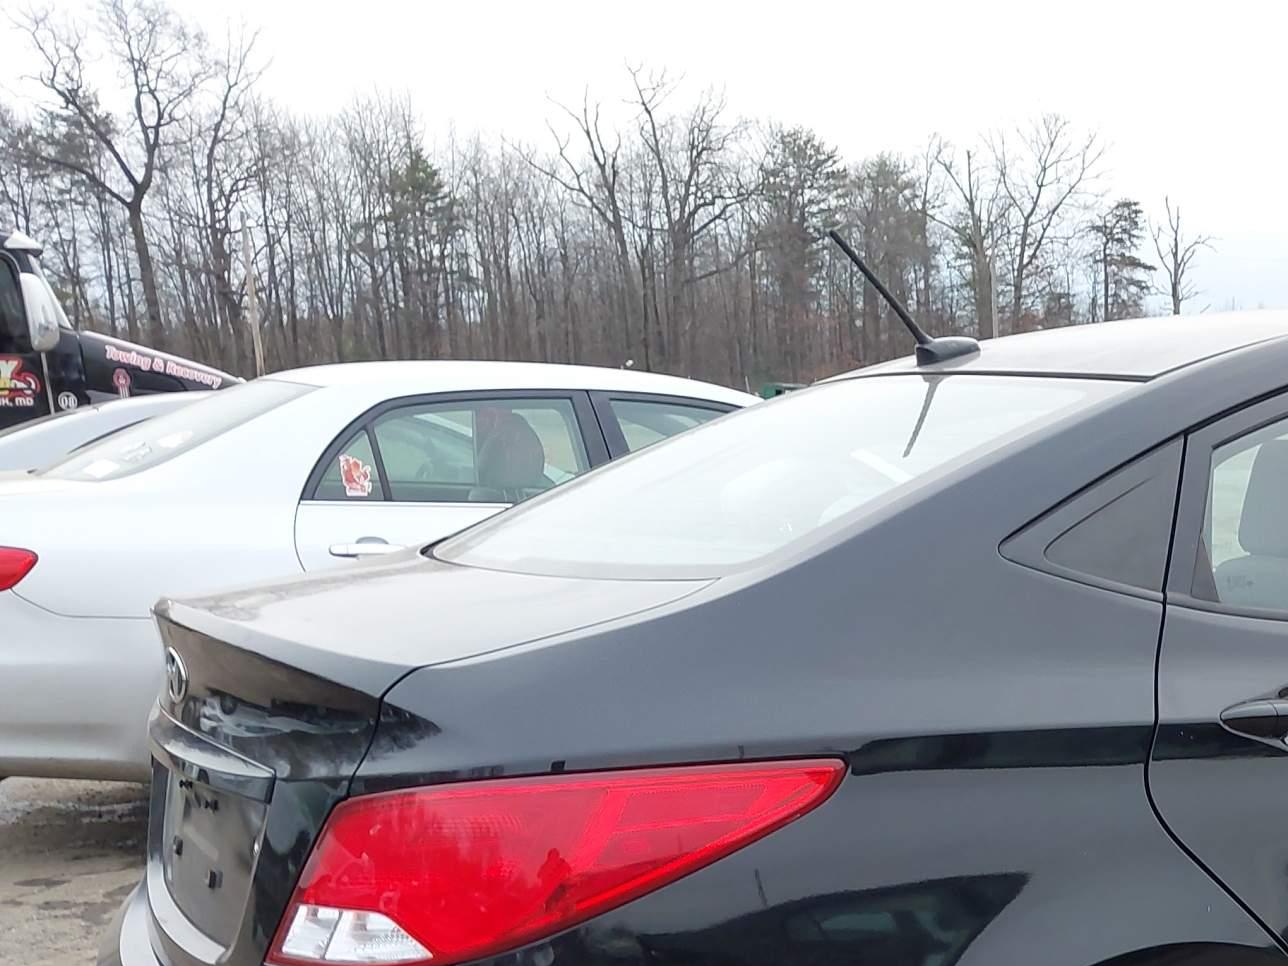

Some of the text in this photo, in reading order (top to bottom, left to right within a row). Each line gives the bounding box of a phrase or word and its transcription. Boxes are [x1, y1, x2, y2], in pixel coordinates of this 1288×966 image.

[105, 345, 222, 389] Towing & Recovery
